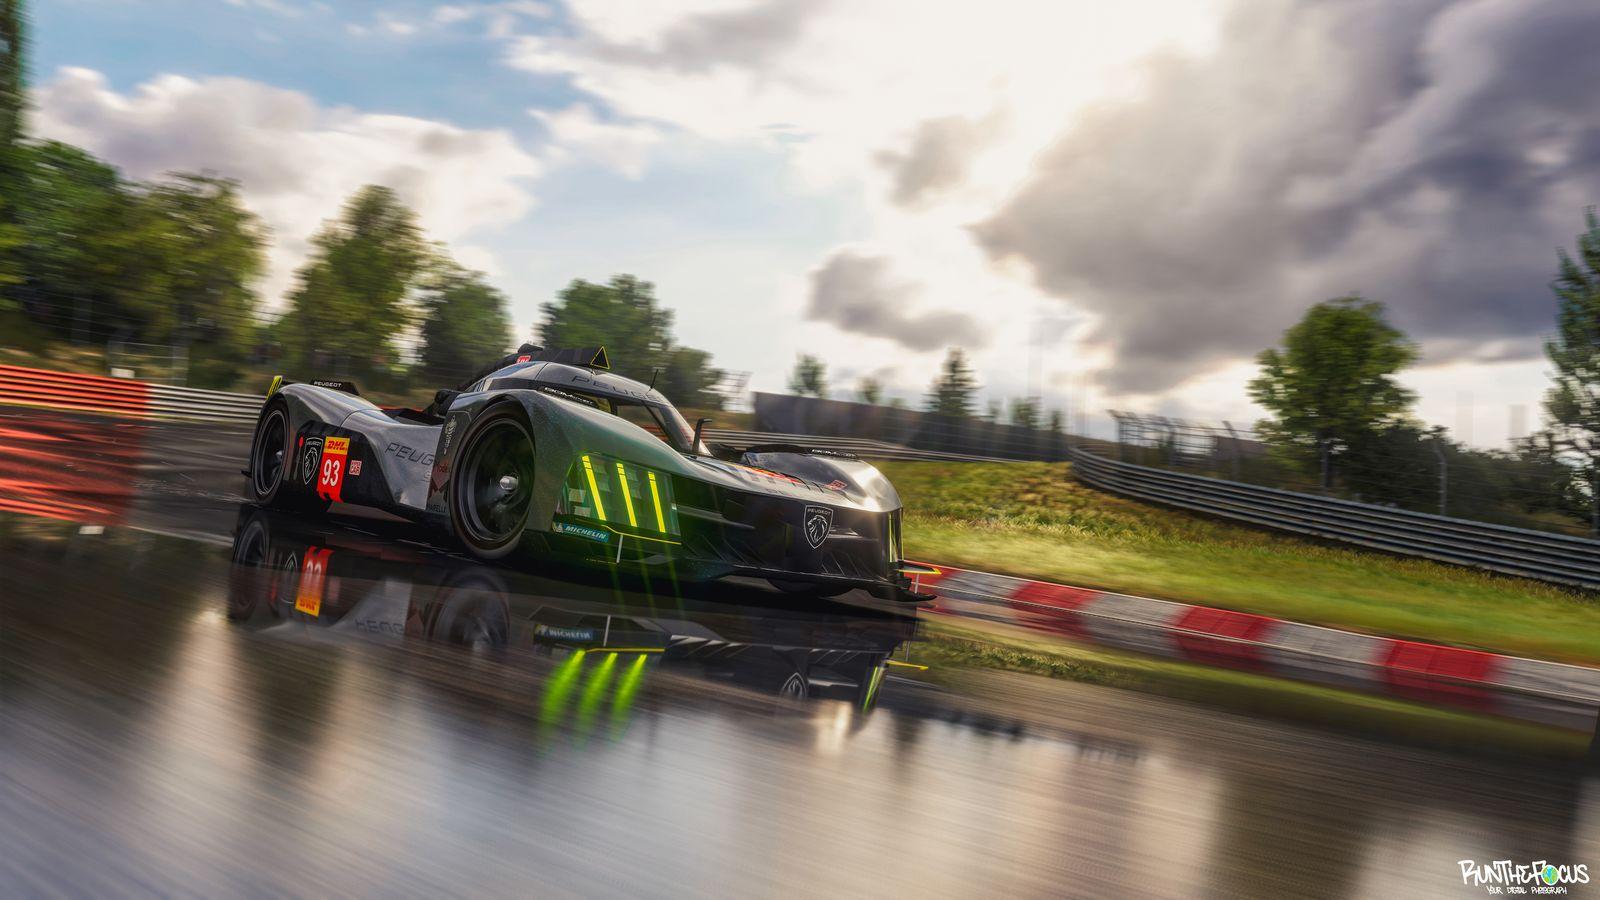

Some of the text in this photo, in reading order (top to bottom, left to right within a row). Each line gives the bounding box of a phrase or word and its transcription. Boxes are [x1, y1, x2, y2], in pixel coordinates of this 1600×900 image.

[327, 440, 347, 451] DHL
[322, 459, 341, 487] 93
[565, 526, 606, 539] MICHELIN
